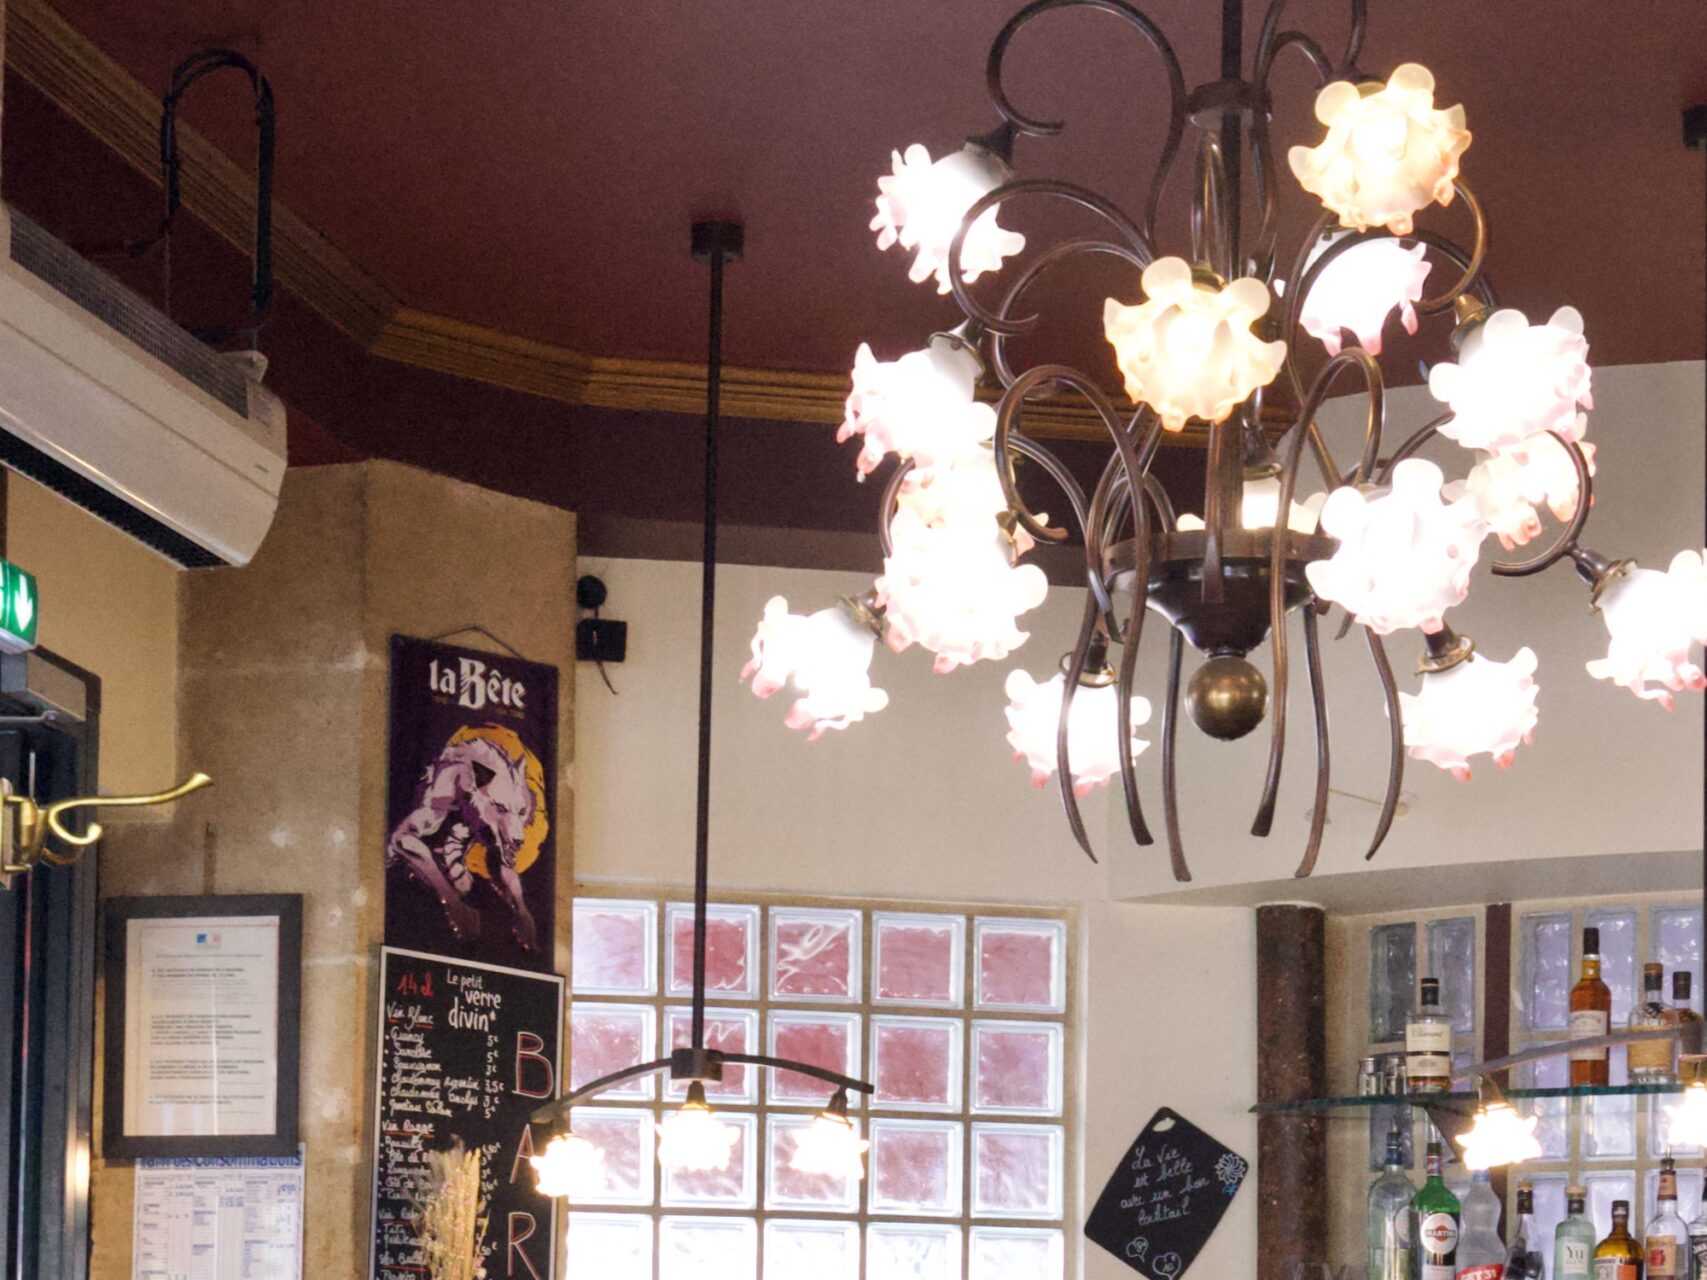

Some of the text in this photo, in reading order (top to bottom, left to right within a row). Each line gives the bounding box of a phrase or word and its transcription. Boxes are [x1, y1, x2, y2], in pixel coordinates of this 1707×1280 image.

[429, 657, 526, 709] la Bête
[447, 968, 483, 992] Le petit
[448, 996, 489, 1032] divin
[465, 990, 501, 1009] verre
